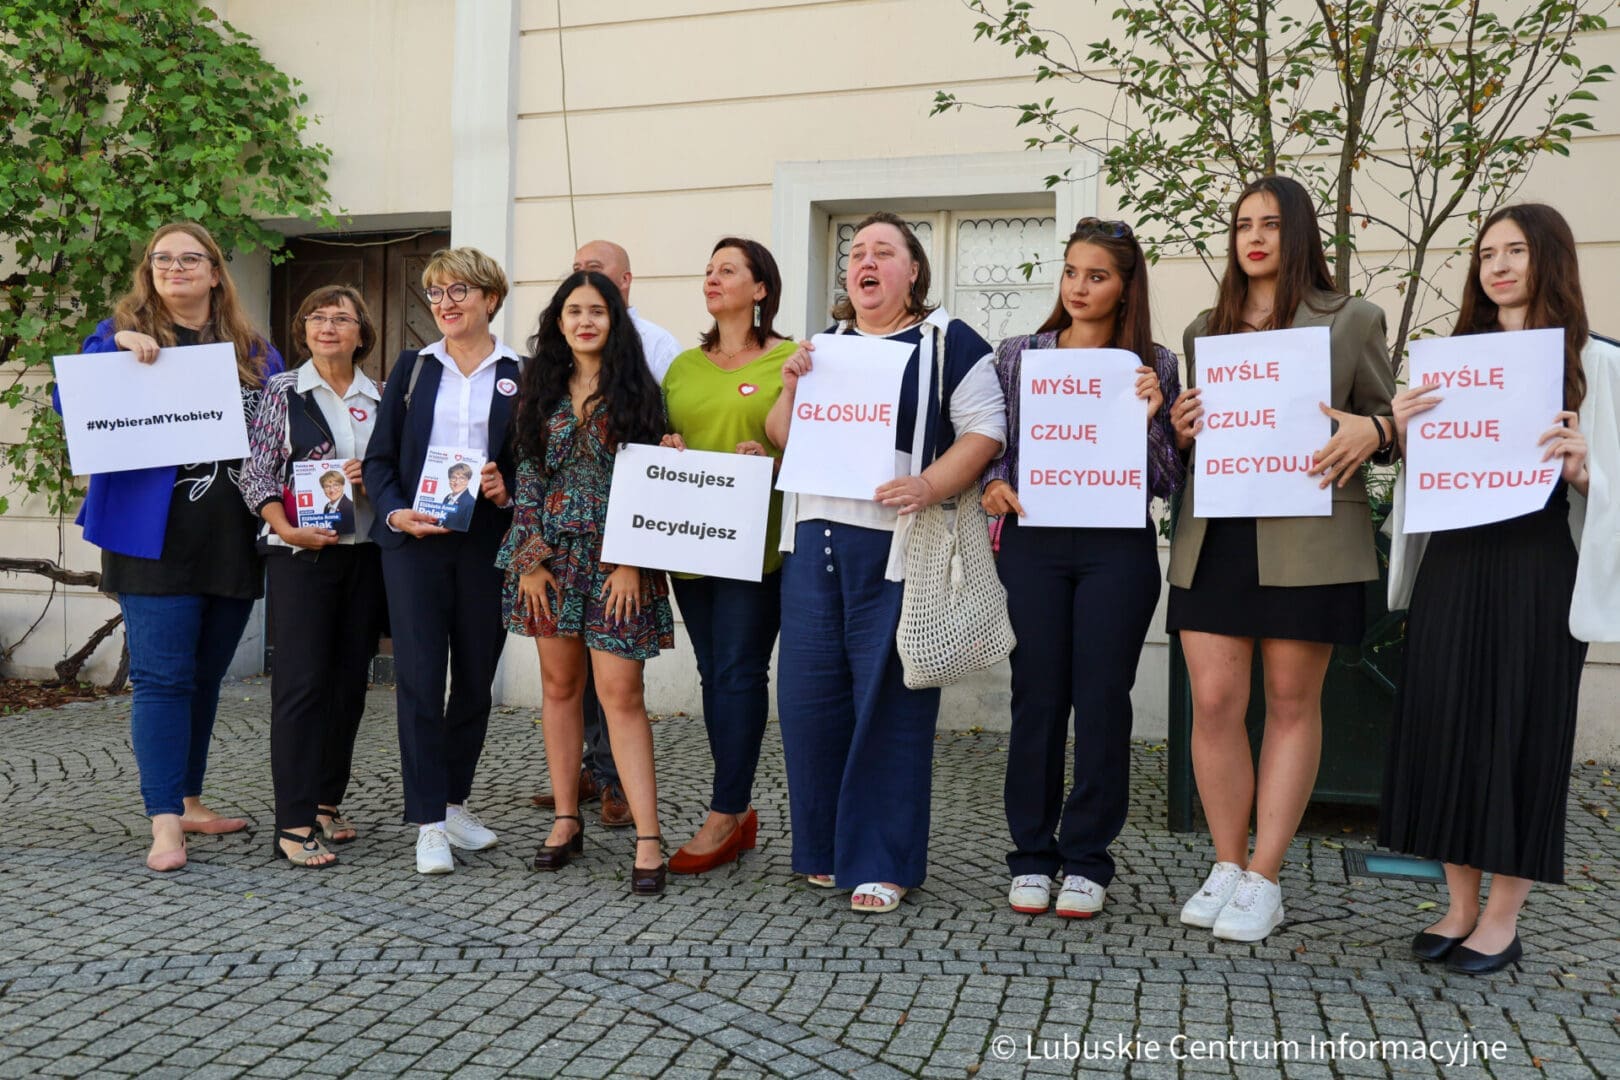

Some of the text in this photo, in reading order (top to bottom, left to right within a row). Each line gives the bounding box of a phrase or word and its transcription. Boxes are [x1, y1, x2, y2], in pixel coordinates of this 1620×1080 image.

[1207, 360, 1280, 384] MYŚLĘ
[1422, 365, 1504, 390] MYŚLĘ
[1031, 374, 1102, 399] MYŚLĘ
[86, 410, 224, 431] #WybieraMYkobiety
[797, 402, 892, 427] GŁOSUJĘ
[1207, 409, 1276, 429] CZUJĘ
[1030, 424, 1097, 444] CZUJĘ
[1420, 420, 1500, 442] CZUJĘ
[646, 465, 736, 488] Głosujesz
[1030, 469, 1142, 490] DECYDUJĘ
[1419, 468, 1555, 490] DECYDUJĘ
[302, 520, 333, 528] Polak
[632, 514, 737, 540] Decydujesz
